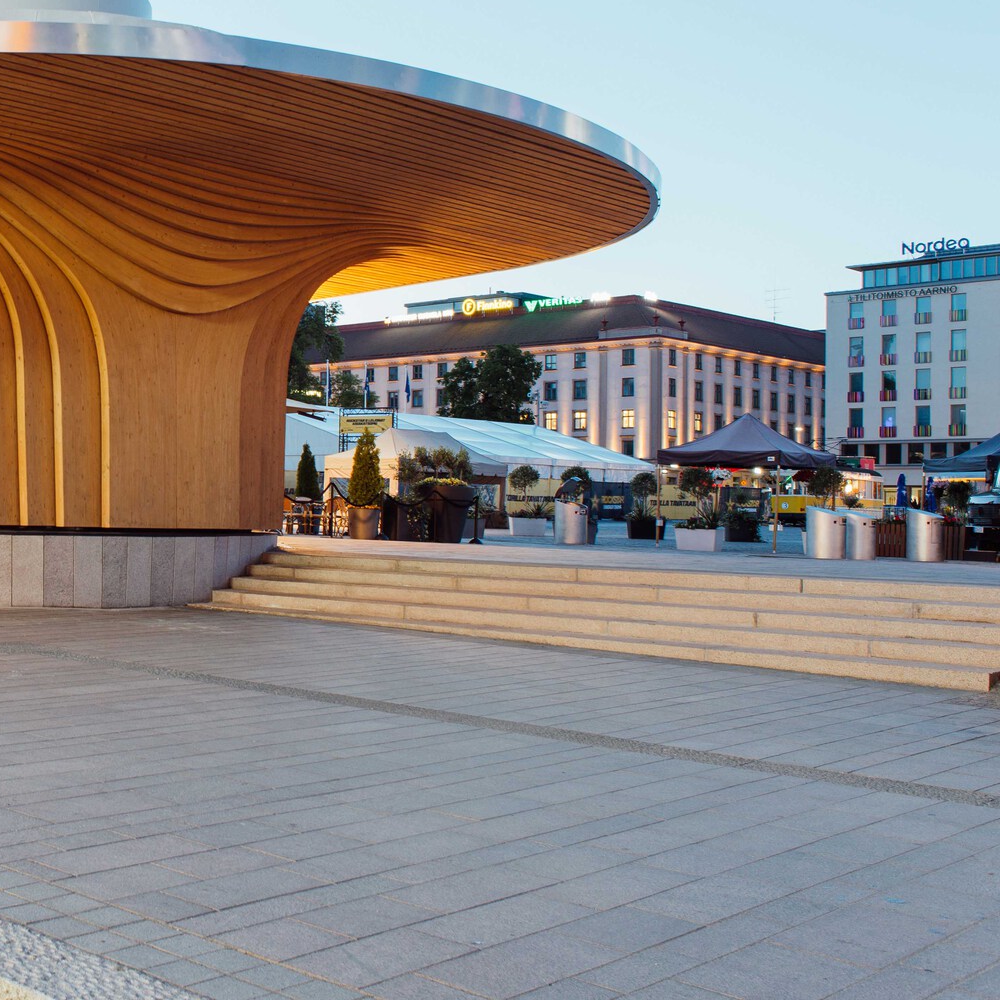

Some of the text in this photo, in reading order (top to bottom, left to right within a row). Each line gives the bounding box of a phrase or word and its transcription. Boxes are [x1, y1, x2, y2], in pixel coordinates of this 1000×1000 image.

[902, 237, 970, 255] Nordea
[855, 285, 958, 302] TILITOIMISTO AARNIO
[476, 299, 514, 312] Finnkino
[538, 296, 583, 308] VERITAS
